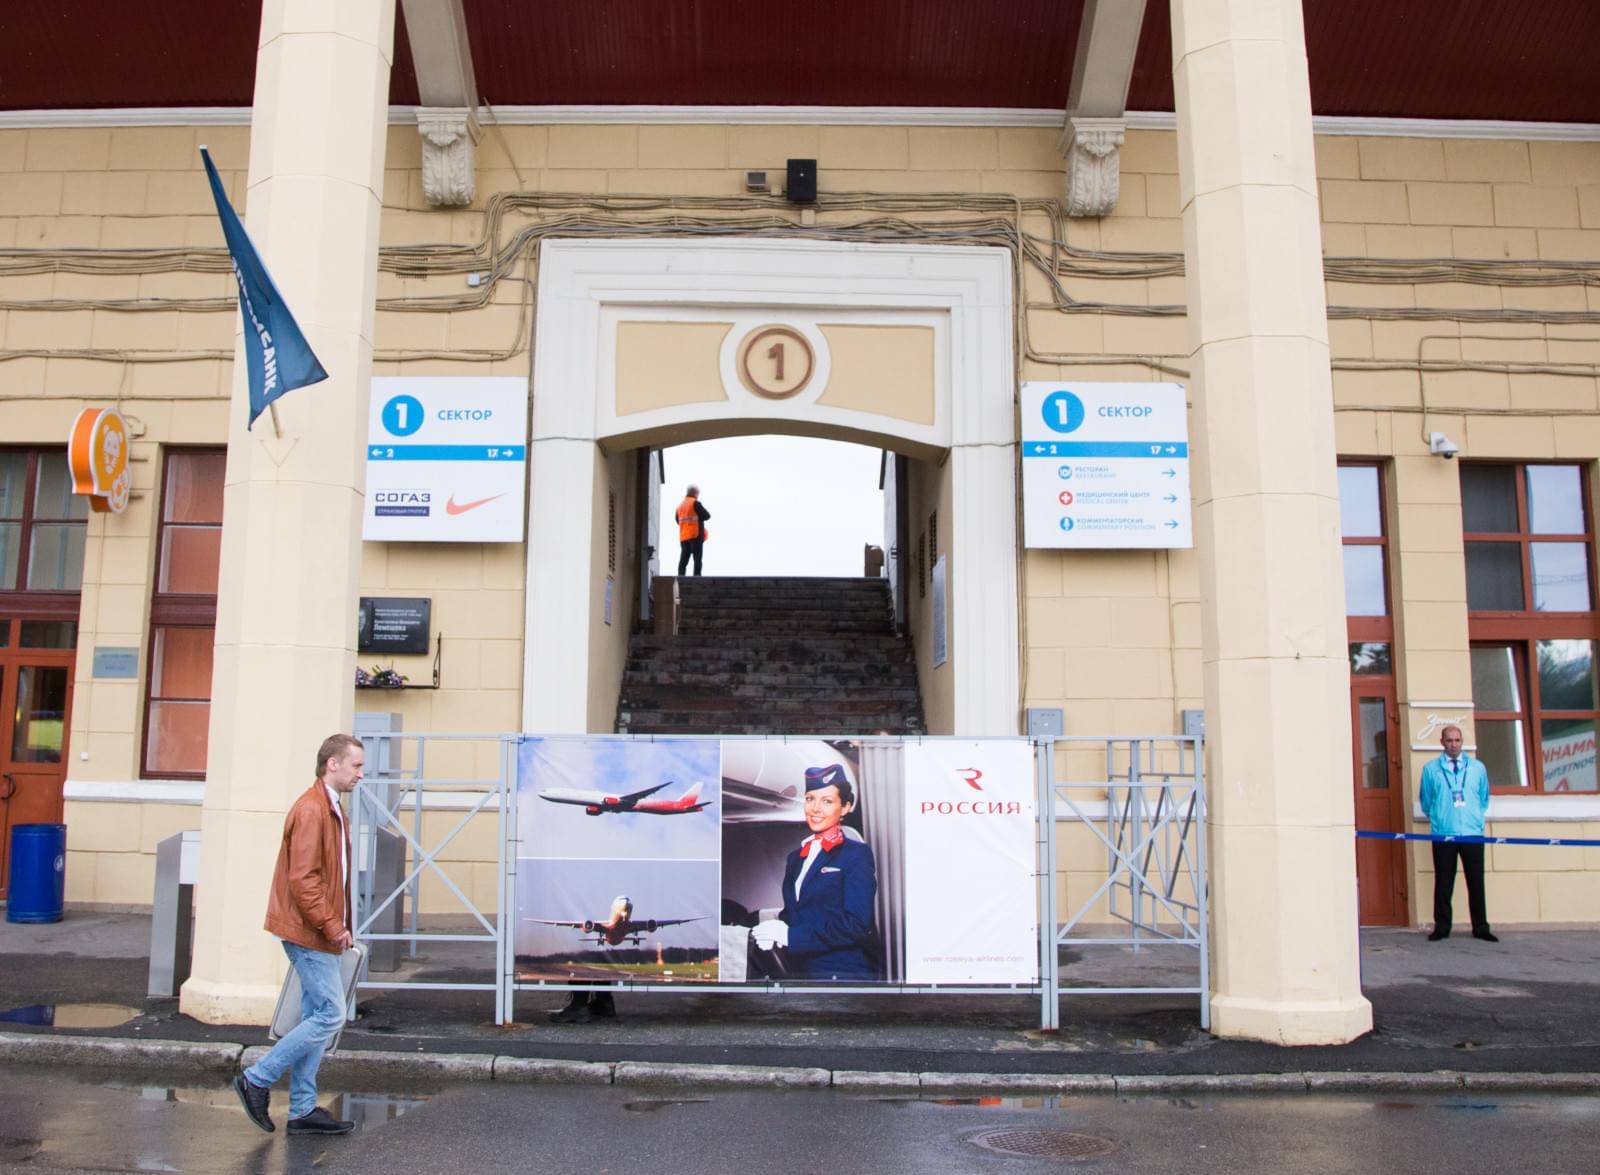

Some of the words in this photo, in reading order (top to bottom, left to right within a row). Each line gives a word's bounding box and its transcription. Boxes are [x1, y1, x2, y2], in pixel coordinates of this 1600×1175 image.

[767, 342, 785, 381] 1
[395, 402, 408, 429] 1
[437, 409, 493, 421] СЕКТОР
[1055, 398, 1068, 425] 1
[1097, 406, 1153, 417] СЕКТОР
[386, 448, 394, 458] 2
[487, 448, 499, 458] 17
[1049, 445, 1058, 454] 2
[1151, 445, 1162, 455] 17
[375, 493, 431, 502] СОГАЗ
[921, 801, 1021, 815] РОССИЯ
